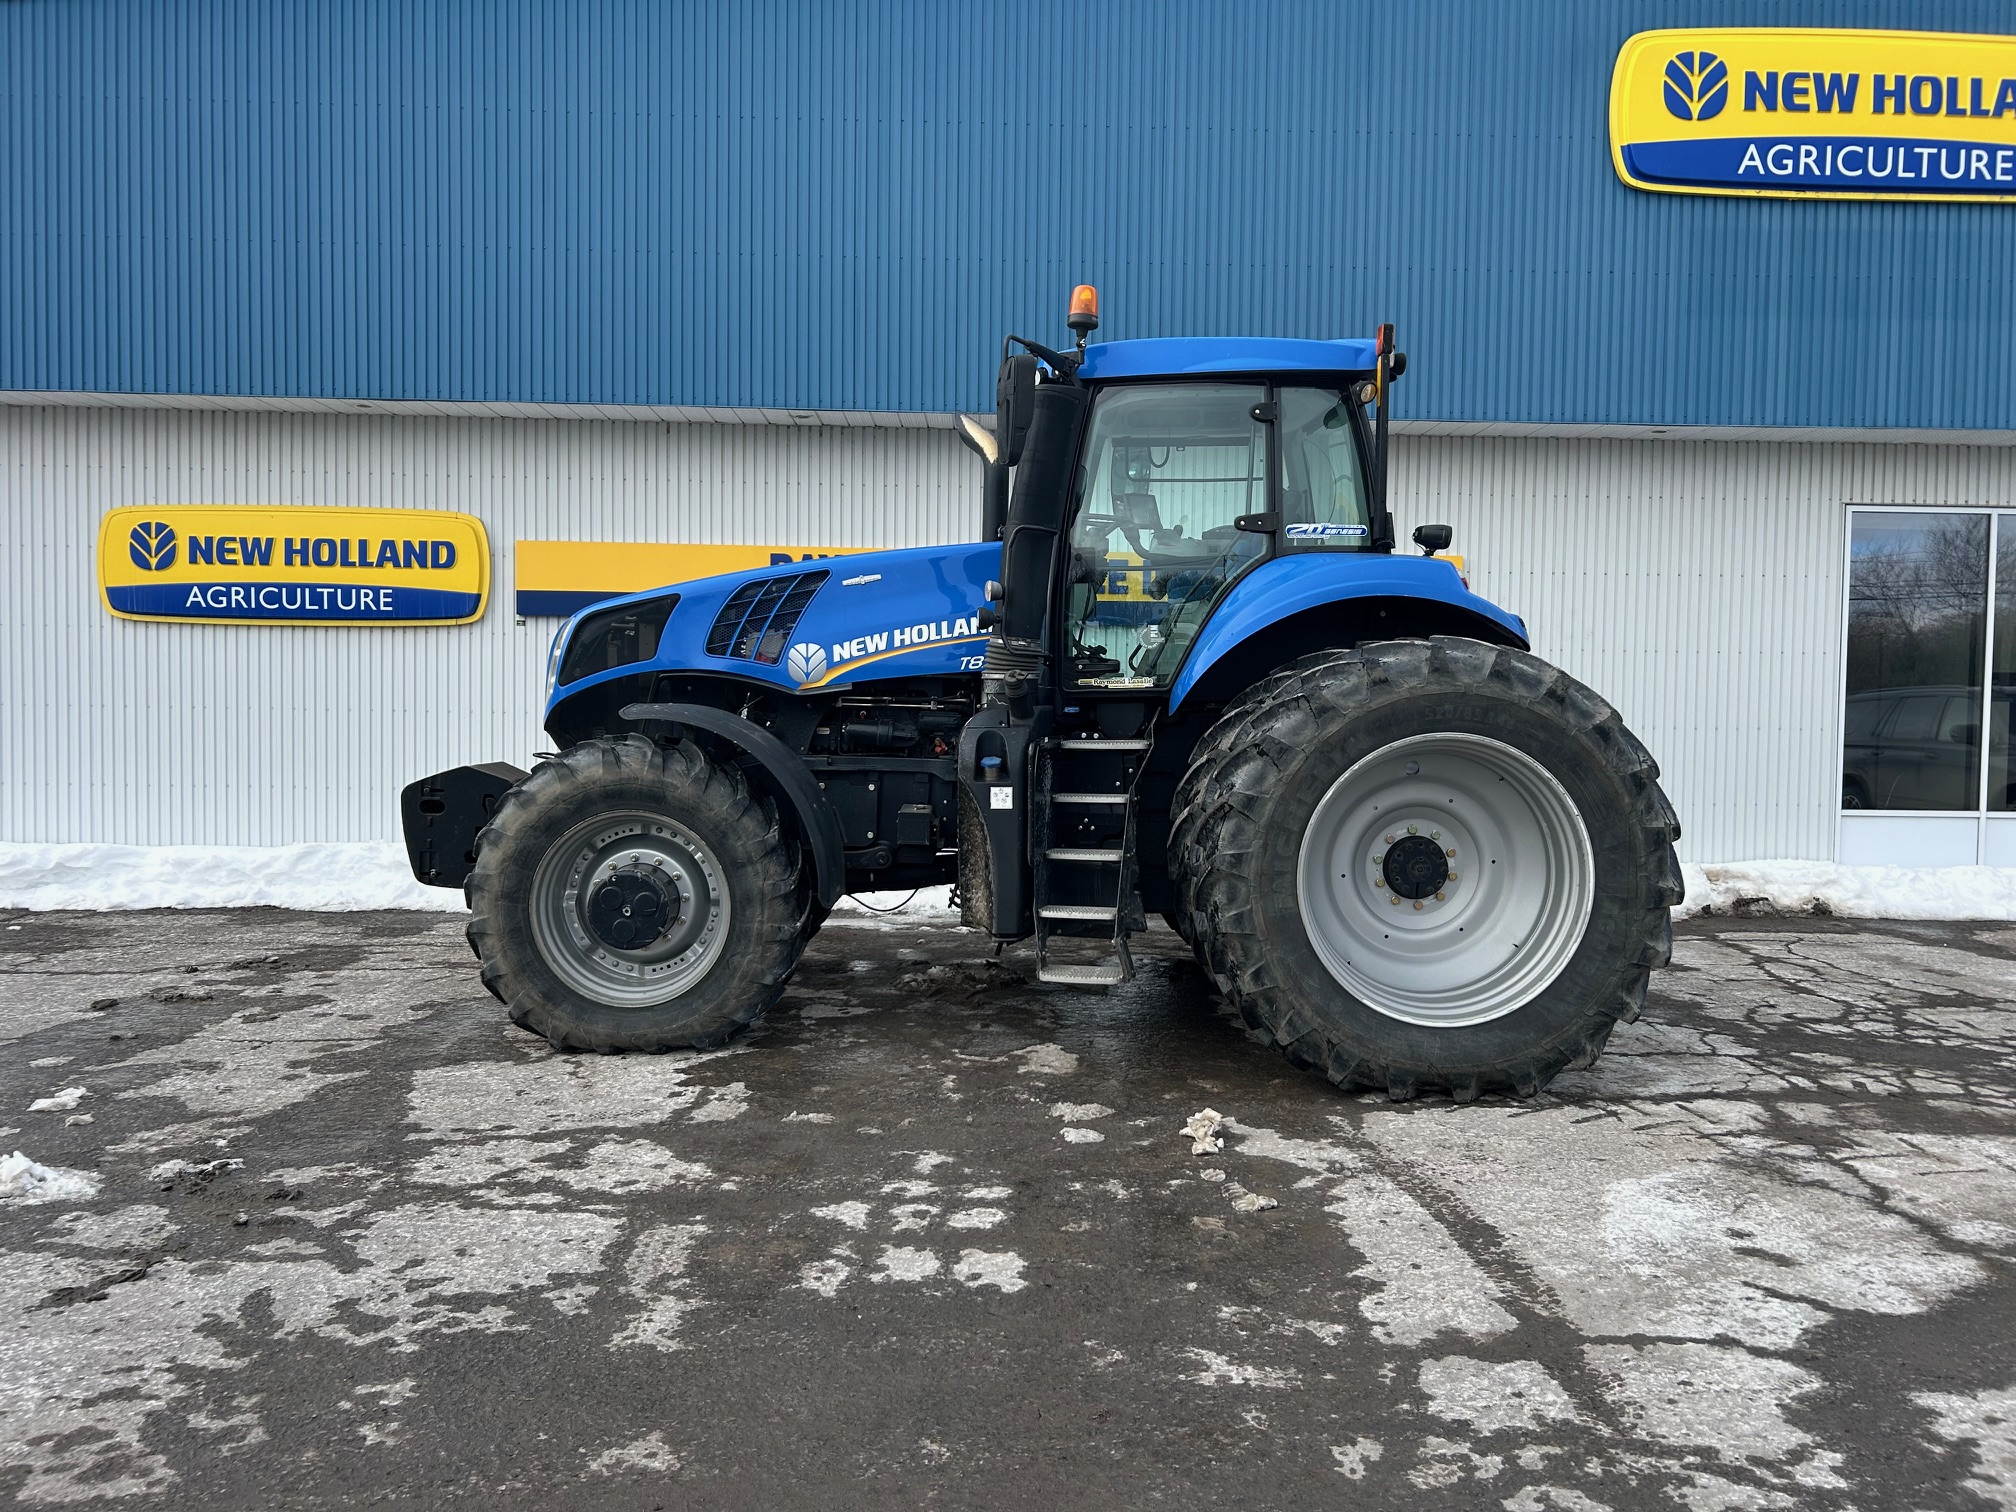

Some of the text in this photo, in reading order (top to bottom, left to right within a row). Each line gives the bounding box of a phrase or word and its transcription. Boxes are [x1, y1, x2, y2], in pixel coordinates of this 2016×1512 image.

[1743, 70, 1860, 113] NEW
[1738, 143, 2014, 181] AGRICULTURE
[188, 536, 457, 569] NEW HOLLAND
[185, 586, 394, 611] AGRICULTURE
[832, 616, 994, 663] NEW HOLLAN
